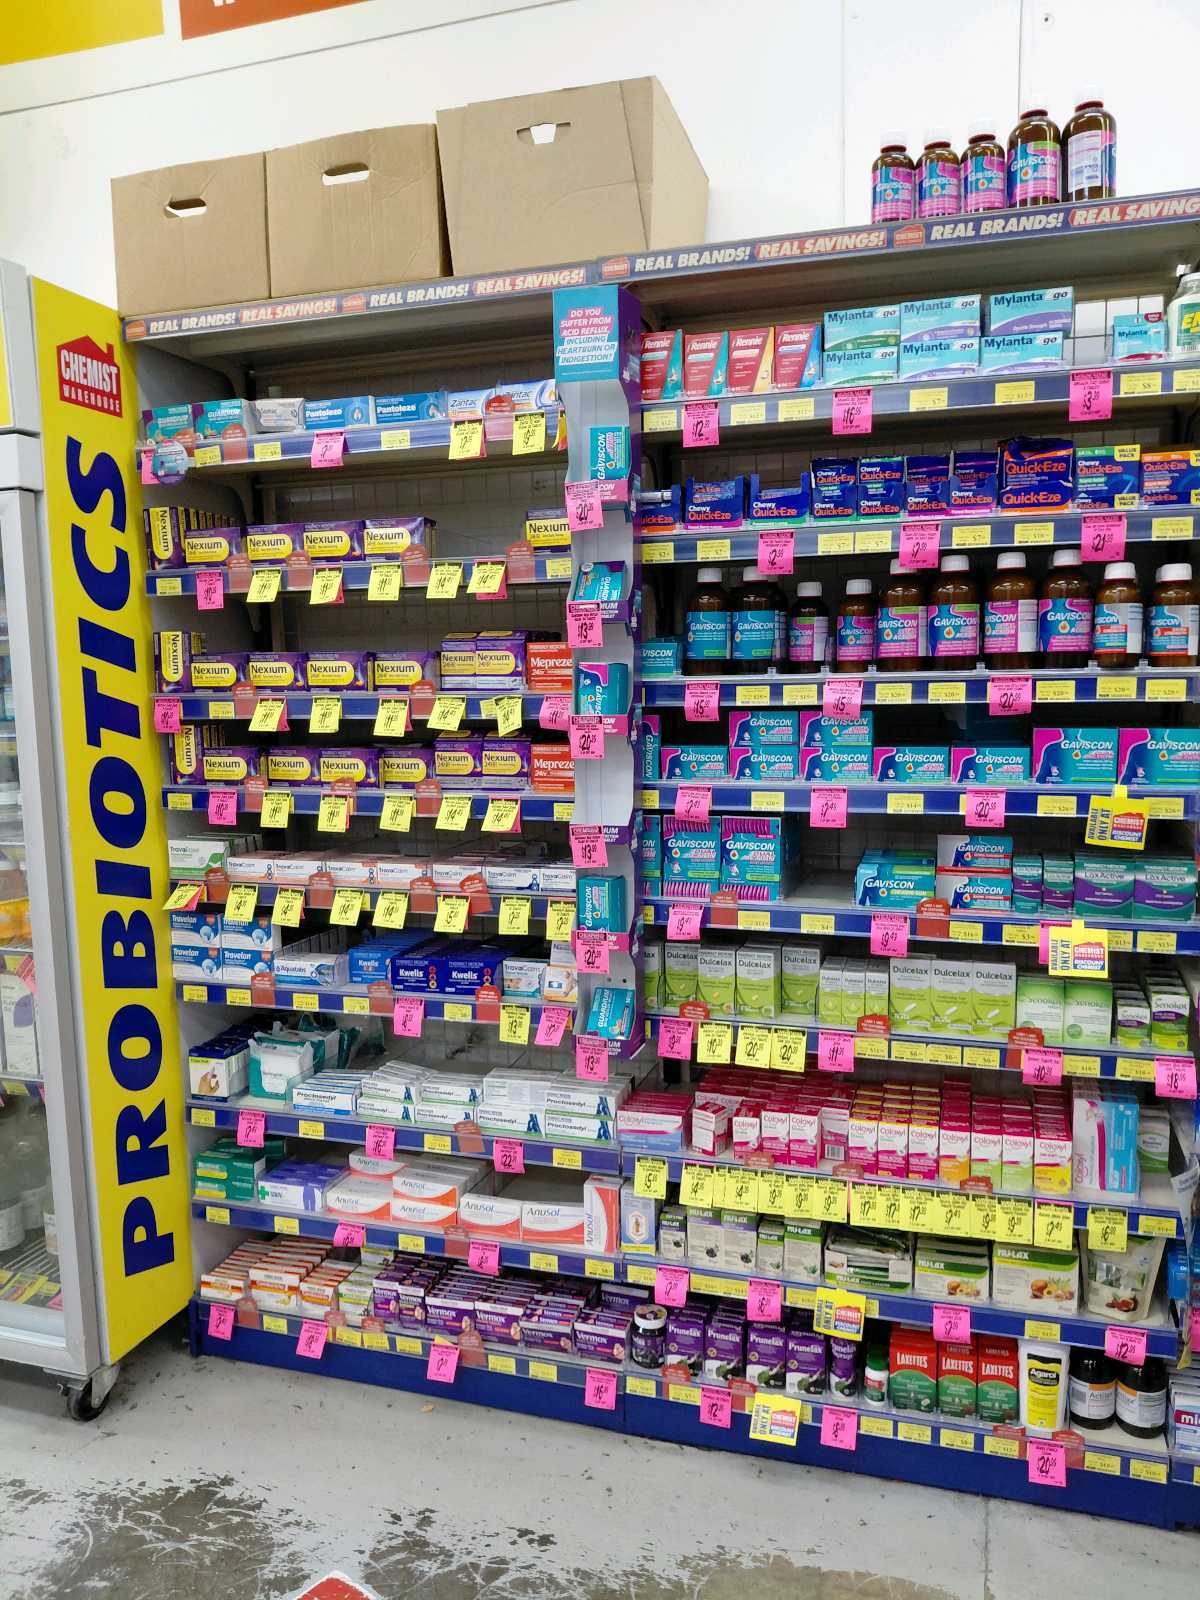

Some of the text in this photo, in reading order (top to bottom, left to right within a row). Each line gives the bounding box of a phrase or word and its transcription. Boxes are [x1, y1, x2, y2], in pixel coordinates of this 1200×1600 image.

[1011, 156, 1058, 171] GAVISCON
[931, 224, 975, 241] REAL
[980, 212, 1063, 235] BRANDS!
[1074, 206, 1121, 226] REAL
[635, 231, 886, 272] REAL BRANDS! REAL SAVINGS!
[370, 269, 584, 307] REAL BRANDS! REAL SAVINGS!
[993, 289, 1068, 306] Mylanta go
[904, 298, 975, 314] Mylanta go
[150, 300, 337, 333] REAL BRANDS! REAL SAVINGS!
[571, 308, 602, 318] DO YOU
[828, 307, 897, 325] Mylanta go
[560, 316, 612, 328] SUFFER FROM
[581, 326, 609, 335] REFLUX
[1118, 329, 1148, 339] Mylanta
[566, 336, 606, 345] INCLUDING
[735, 336, 762, 347] Rennie
[783, 331, 810, 343] Rennie
[984, 334, 1057, 350] Mylanta go
[644, 337, 670, 349] Rennie
[691, 338, 718, 350] Rennie
[903, 340, 974, 355] Mylanta go
[557, 343, 615, 355] HEARTBURN OR
[826, 349, 894, 364] Mylanta go
[60, 348, 119, 396] CHEMIST
[63, 383, 122, 413] WAREHOUSE
[450, 398, 478, 409] Zantac
[597, 432, 606, 480] GAVISCON
[688, 505, 710, 513] Chewy
[753, 501, 775, 509] Chewy
[160, 509, 169, 552] Nexium
[528, 523, 570, 533] Nexium
[305, 534, 343, 544] Nexium
[366, 531, 404, 541] Nexium
[187, 541, 222, 550] Nexium
[249, 538, 286, 547] Nexium
[690, 622, 726, 631] GAVISCON
[738, 622, 775, 630] GAVISCON
[934, 617, 977, 627] GAVISCON
[172, 633, 180, 675] Nexium
[442, 653, 475, 662] Nexium
[477, 652, 510, 661] Nexium
[193, 666, 230, 675] Nexium
[251, 664, 287, 674] Nexium
[310, 663, 347, 673] Nexium
[377, 663, 415, 673] Nexium
[750, 718, 792, 727] GAVISCON
[821, 717, 868, 726] GAVISCON
[184, 727, 193, 768] Nexium
[1061, 740, 1113, 750] GAVISCON
[437, 753, 469, 763] Nexium
[484, 753, 516, 763] Nexium
[680, 753, 724, 763] GAVISCON
[751, 754, 793, 763] GAVISCON
[821, 753, 868, 762] GAVISCON
[895, 753, 944, 763] GAVISCON
[975, 755, 1023, 764] GAVISCON
[205, 758, 241, 768] Nexium
[270, 758, 305, 768] Nexium
[322, 760, 360, 770] Nexium
[383, 760, 420, 770] Nexium
[1113, 818, 1144, 826] CHEMIST
[668, 839, 716, 849] GAVISCON
[726, 840, 776, 851] GAVISCON
[958, 843, 1005, 853] GAVISCON
[66, 435, 175, 1277] PROBIOTICS
[865, 879, 915, 889] GAVISCON
[957, 885, 1004, 895] GAVISCON
[172, 914, 197, 924] Travelan
[173, 948, 199, 957] Travelan
[224, 950, 252, 960] Travelan
[358, 959, 379, 968] Kwells
[399, 968, 424, 978] Kwells
[451, 970, 478, 980] Kwells
[464, 1201, 495, 1213] Anusol
[527, 1207, 560, 1217] Anusol
[586, 1213, 594, 1246] Anusol
[428, 1307, 456, 1318] Vermox
[476, 1310, 506, 1322] Vermox
[668, 1326, 700, 1338] Prunelax
[707, 1329, 740, 1343] Prunelax
[577, 1331, 608, 1344] Vermox
[750, 1335, 784, 1347] Prunelax
[788, 1342, 823, 1354] Prunelax
[897, 1352, 928, 1369] LAXETTES
[942, 1357, 974, 1374] LAXETTES
[982, 1362, 1014, 1379] LAXETTES
[1029, 1367, 1057, 1379] Agarol
